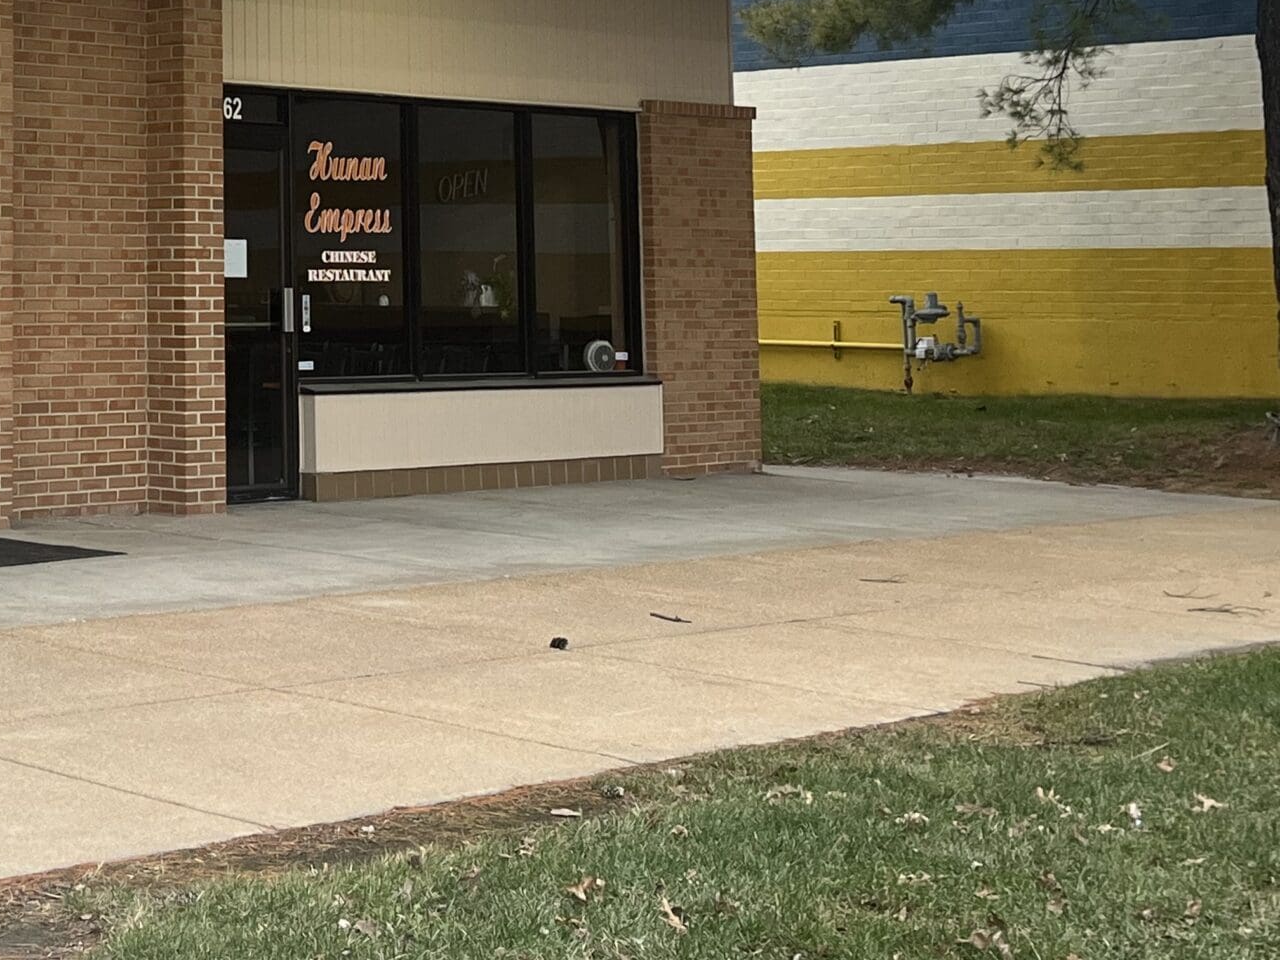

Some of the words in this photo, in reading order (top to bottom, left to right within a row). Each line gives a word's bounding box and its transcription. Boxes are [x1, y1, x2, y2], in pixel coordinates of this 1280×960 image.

[307, 140, 388, 181] Hunan
[438, 167, 489, 202] OPEN
[304, 192, 393, 243] Empress
[321, 250, 377, 264] CHINESE
[307, 268, 391, 282] RESTAURANT
